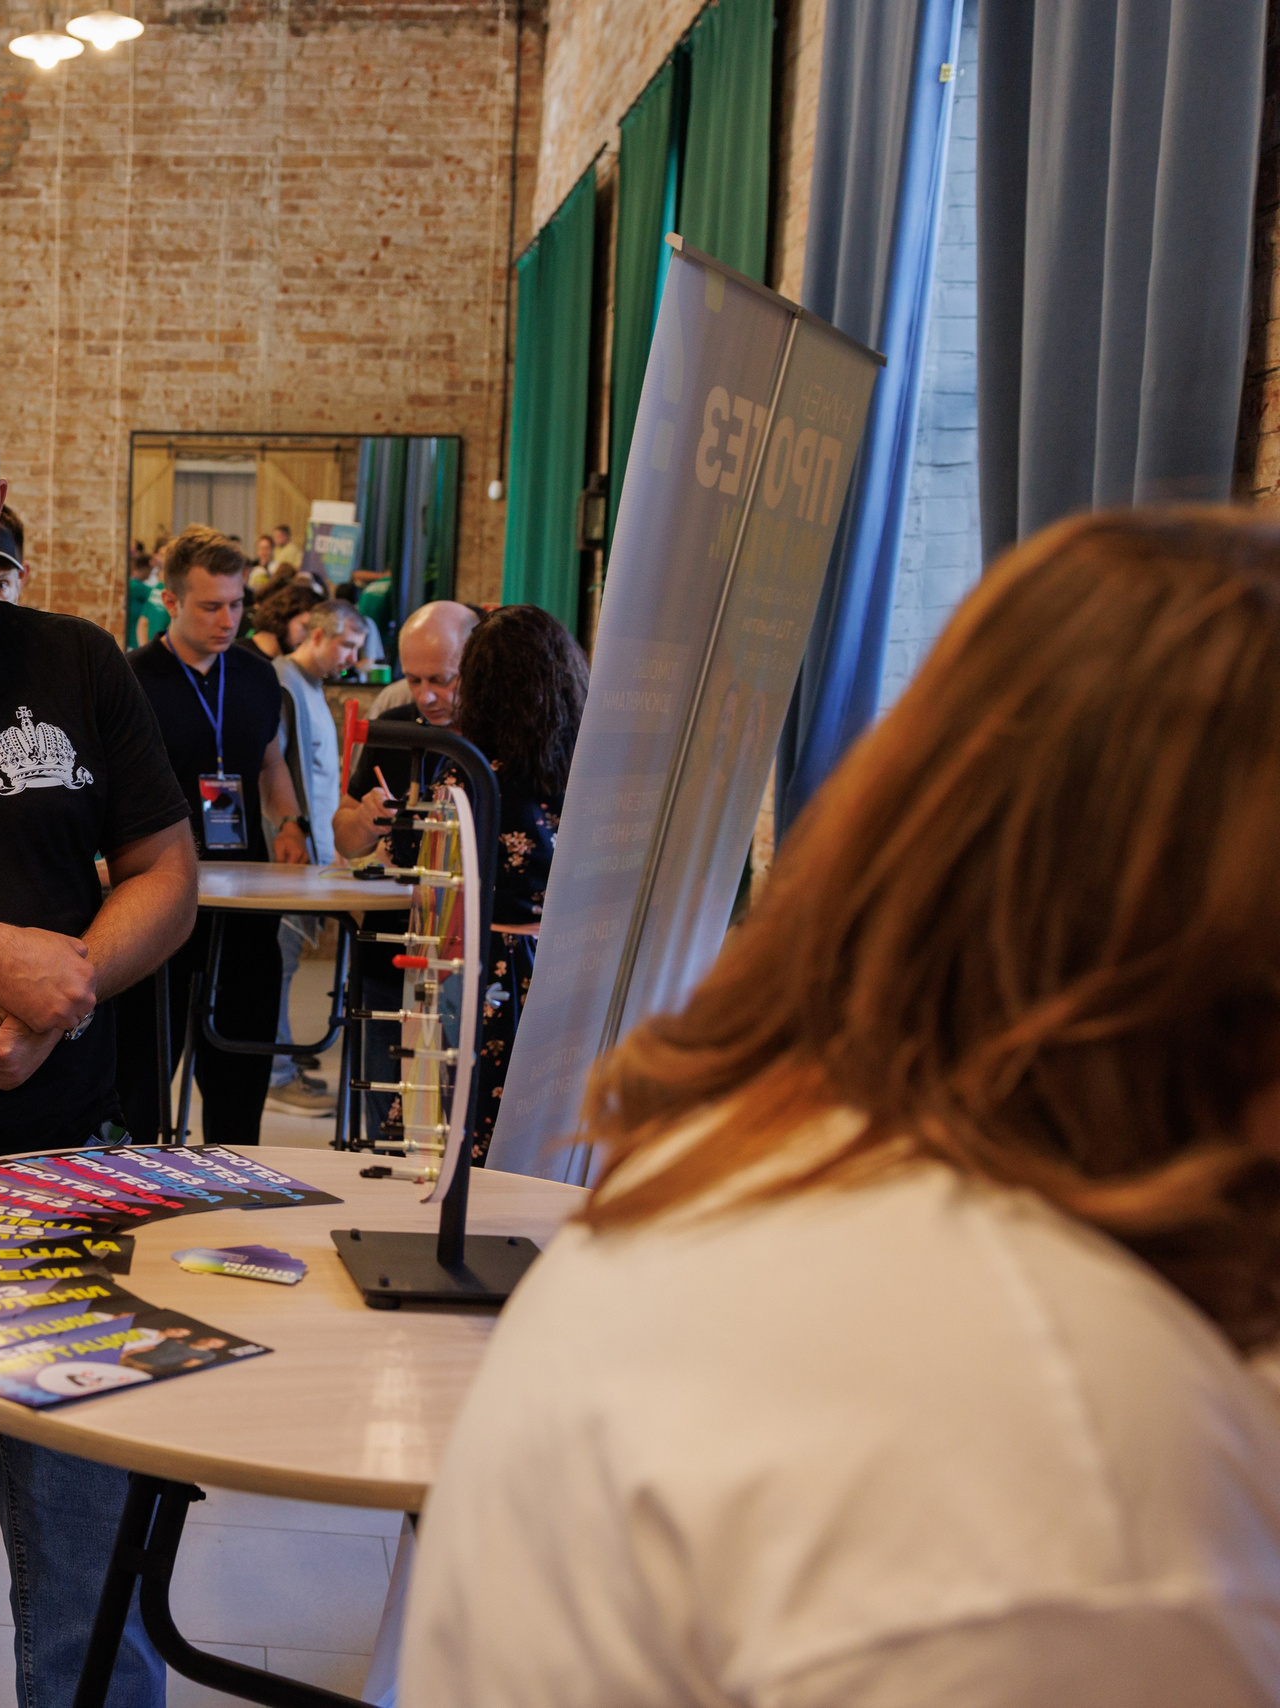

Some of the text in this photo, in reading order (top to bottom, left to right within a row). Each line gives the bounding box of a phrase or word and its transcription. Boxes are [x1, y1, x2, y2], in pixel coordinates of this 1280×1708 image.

[0, 1162, 117, 1198] ПРОТЕЗ
[60, 1154, 162, 1191] ПРОТЕЗ
[109, 1148, 206, 1186] ПРОТЕЗ
[167, 1146, 251, 1185] ПРОТЕЗ
[202, 1146, 292, 1184] ПРОТЕЗ
[140, 1171, 224, 1204] БЕДРА
